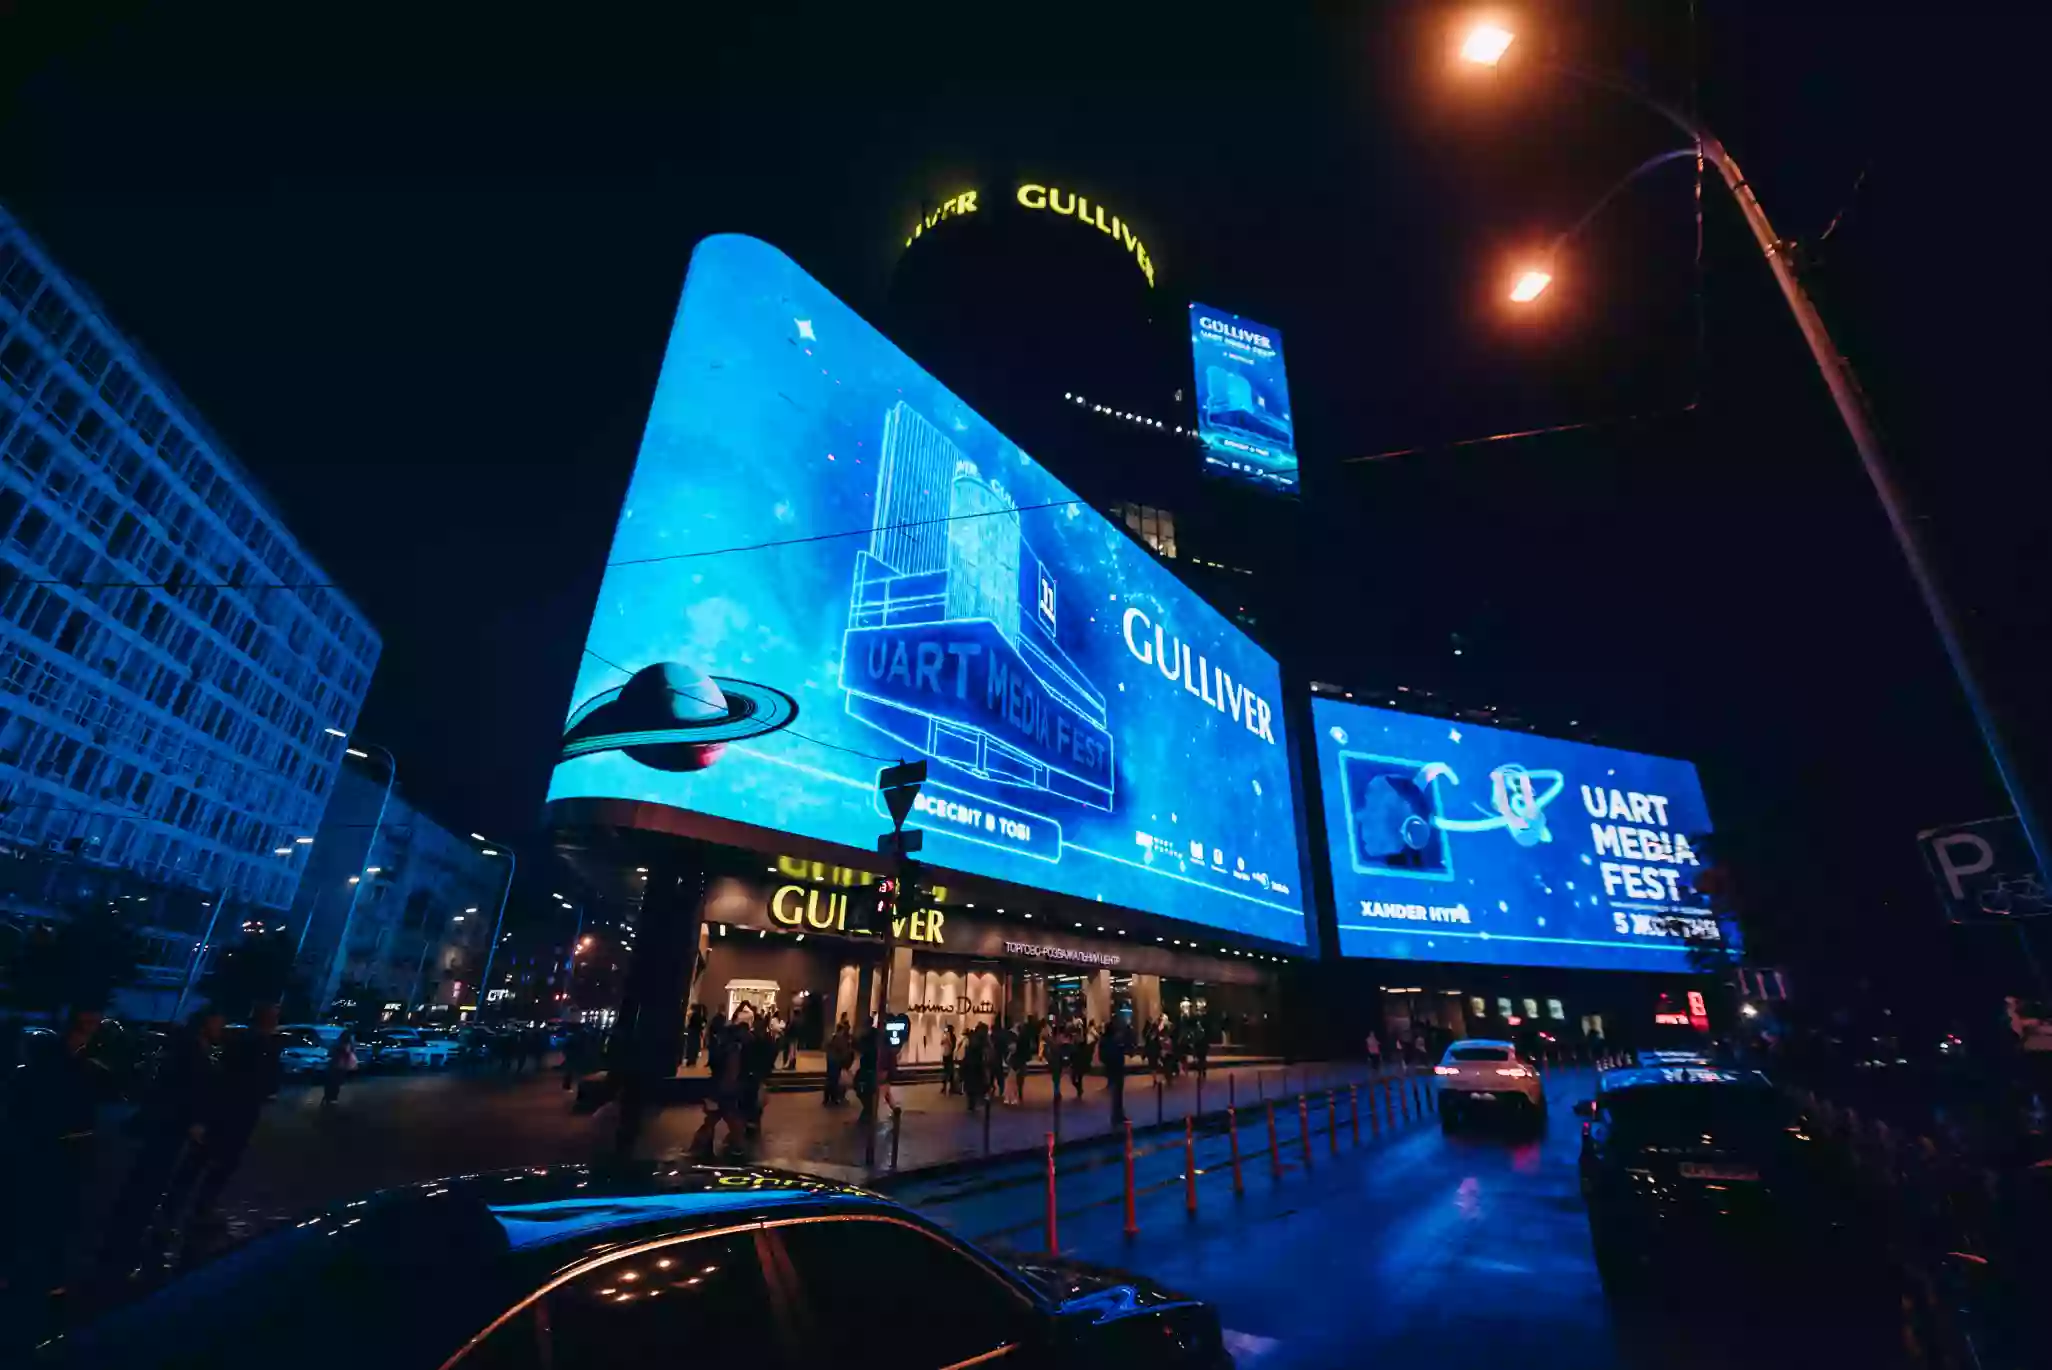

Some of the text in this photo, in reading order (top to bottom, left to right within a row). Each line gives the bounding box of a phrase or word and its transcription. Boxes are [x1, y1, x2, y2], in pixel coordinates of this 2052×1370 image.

[1199, 316, 1271, 349] GULLIVER
[1123, 607, 1275, 745] GULLIVER
[867, 640, 1106, 769] UART MEDIA FEST
[1580, 784, 1668, 826] UART
[1591, 822, 1700, 867] MEDIA
[1601, 861, 1681, 902] FEST
[1932, 833, 1993, 901] P
[1360, 900, 1427, 921] XANDER
[1613, 911, 1629, 935] 5
[1100, 953, 1121, 966] ЦЕНТР
